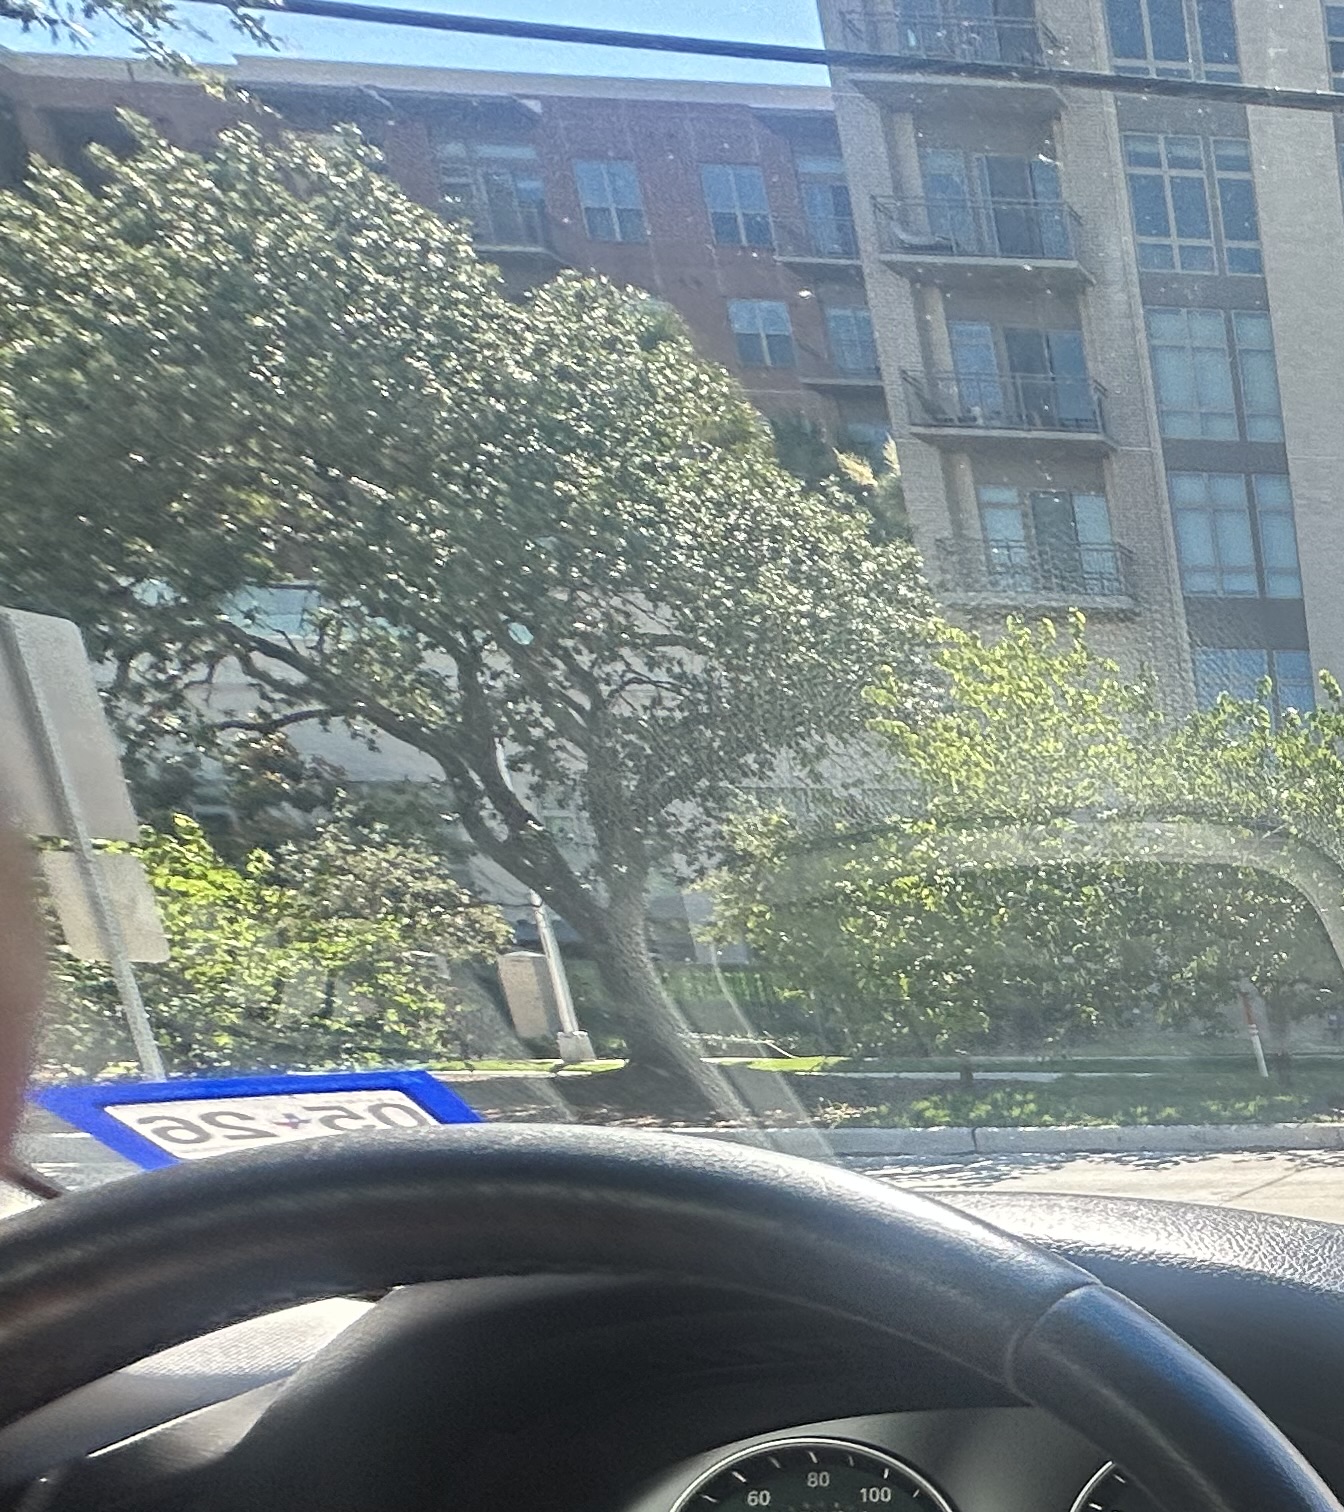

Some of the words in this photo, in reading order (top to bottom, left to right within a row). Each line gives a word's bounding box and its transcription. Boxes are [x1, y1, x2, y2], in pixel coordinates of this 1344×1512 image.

[806, 1471, 830, 1488] 80
[747, 1489, 771, 1506] 60
[860, 1486, 892, 1503] 100
